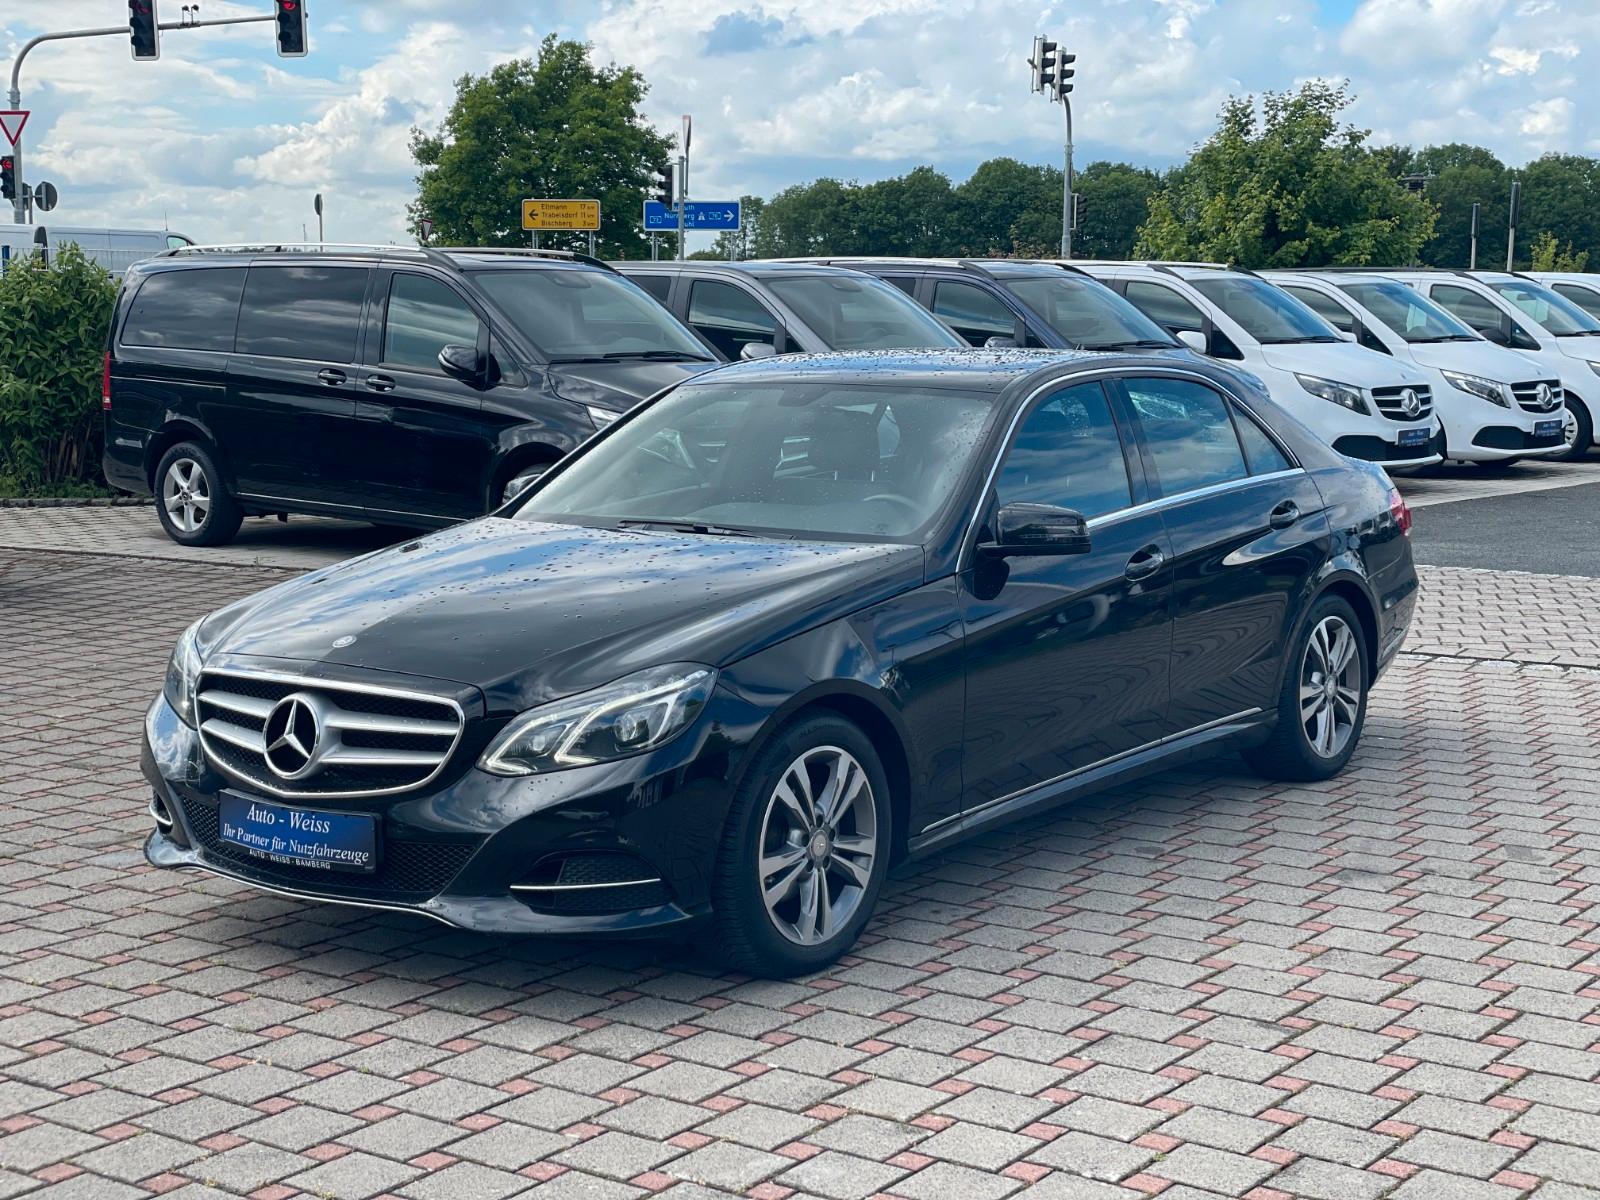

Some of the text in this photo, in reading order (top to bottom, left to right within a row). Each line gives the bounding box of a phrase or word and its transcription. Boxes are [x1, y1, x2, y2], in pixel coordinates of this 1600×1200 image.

[247, 804, 275, 825] Auto
[289, 812, 330, 833] Weiss
[223, 823, 369, 865] Ihr Partner für Nutzfahrzeuge
[249, 849, 265, 858] AUTO
[270, 855, 290, 864] WEISS
[295, 858, 330, 870] BAMBERG
